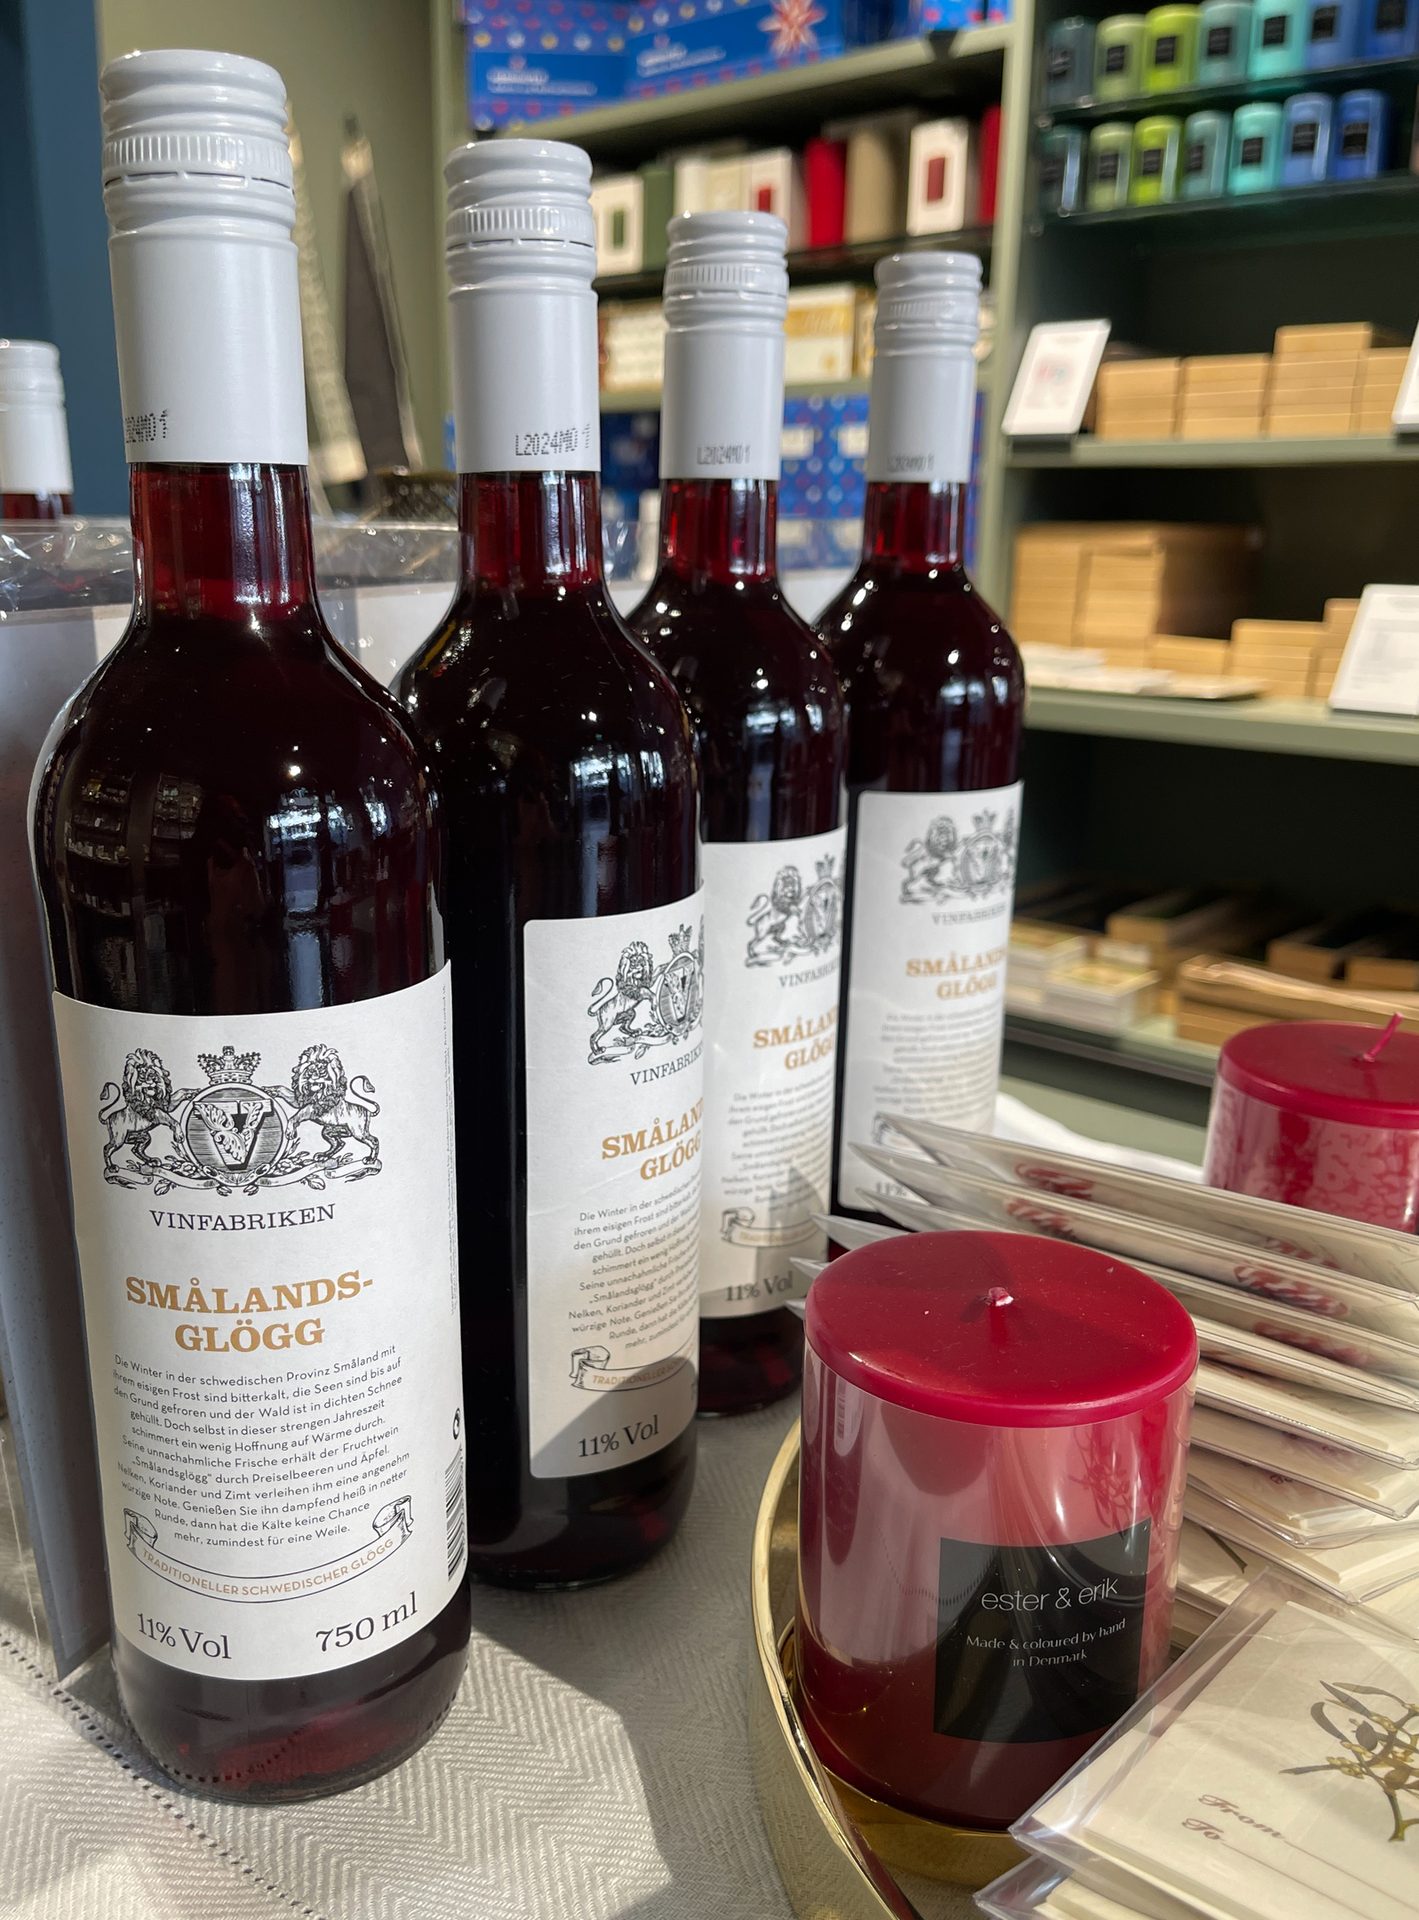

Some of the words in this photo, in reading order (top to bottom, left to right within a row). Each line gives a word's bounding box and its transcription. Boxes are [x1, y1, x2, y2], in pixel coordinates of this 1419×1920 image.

[601, 1097, 704, 1160] SMÅLAN
[148, 1203, 336, 1231] VINFABRIKEN
[573, 1226, 601, 1236] ihrem
[602, 1221, 633, 1232] eisigen
[580, 1212, 595, 1222] Die
[597, 1207, 629, 1219] Winter
[639, 1200, 653, 1210] der
[573, 1241, 591, 1251] den
[593, 1234, 623, 1248] Grund
[125, 1270, 374, 1315] SMÅLANDS-
[579, 1281, 605, 1292] Seine
[725, 1282, 760, 1301] 11%
[763, 1270, 793, 1295] Vol
[174, 1317, 326, 1353] GLÖGG
[571, 1321, 608, 1333] würzige
[114, 1353, 129, 1367] Die
[130, 1360, 163, 1378] Winter
[165, 1370, 175, 1381] in
[177, 1372, 197, 1384] der
[200, 1374, 283, 1386] schwedischen
[286, 1369, 331, 1382] Provinz
[333, 1351, 379, 1373] Småland
[381, 1344, 396, 1358] mit
[137, 1380, 170, 1396] eisigen
[172, 1387, 201, 1402] Frost
[204, 1392, 228, 1402] sind
[230, 1391, 289, 1403] bitterkalt,
[292, 1387, 311, 1398] die
[314, 1381, 343, 1394] Seen
[346, 1371, 368, 1387] sind
[370, 1366, 385, 1379] bis
[386, 1356, 402, 1372] auf
[113, 1386, 129, 1400] den
[129, 1392, 159, 1410] Grund
[161, 1403, 207, 1418] gefroren
[209, 1409, 231, 1419] und
[234, 1408, 255, 1419] der
[258, 1405, 290, 1418] Wald
[293, 1403, 308, 1414] ist
[310, 1401, 321, 1411] in
[323, 1392, 366, 1408] dichten
[367, 1375, 403, 1396] Schnee
[130, 1409, 163, 1427] gehüllt.
[164, 1418, 191, 1432] Doch
[193, 1424, 226, 1436] selbst
[228, 1426, 239, 1435] in
[241, 1424, 278, 1435] dieser
[280, 1416, 331, 1432] strengen
[332, 1398, 386, 1424] Jahreszeit
[131, 1426, 180, 1447] schimmert
[182, 1439, 198, 1449] ein
[199, 1442, 232, 1454] wenig
[234, 1440, 289, 1452] Hoffnung
[291, 1434, 310, 1447] auf
[311, 1429, 353, 1444] Wärme
[354, 1415, 386, 1434] durch.
[578, 1432, 620, 1458] 11%
[623, 1414, 660, 1446] Vol
[122, 1434, 145, 1453] Seine
[147, 1447, 232, 1468] unnachahmliche
[234, 1457, 278, 1468] Frische
[281, 1451, 316, 1464] erhält
[319, 1447, 339, 1459] der
[342, 1426, 400, 1452] Fruchtwein
[215, 1474, 249, 1484] durch
[252, 1465, 335, 1483] Preiselbeeren
[336, 1456, 358, 1471] und
[360, 1445, 390, 1463] Äpfel.
[121, 1480, 151, 1501] würzige
[153, 1493, 180, 1509] Note.
[182, 1501, 237, 1516] Genießen
[239, 1505, 258, 1516] Sie
[260, 1505, 279, 1515] ihn
[281, 1494, 340, 1512] dampfend
[342, 1485, 367, 1502] heiß
[368, 1482, 378, 1493] in
[379, 1468, 408, 1489] netter
[148, 1476, 198, 1496] Koriander
[200, 1489, 222, 1499] und
[224, 1489, 251, 1500] Zimt
[254, 1485, 310, 1499] verleihen
[312, 1482, 333, 1492] ihm
[335, 1475, 359, 1487] eine
[361, 1452, 411, 1479] angenehm
[154, 1508, 189, 1527] Runde,
[190, 1519, 217, 1531] dann
[219, 1521, 238, 1532] hat
[240, 1521, 258, 1531] die
[262, 1518, 292, 1530] Kälte
[294, 1514, 326, 1526] keine
[328, 1501, 370, 1520] Chance
[174, 1531, 203, 1545] mehr,
[206, 1537, 264, 1548] zumindest
[267, 1534, 285, 1545] für
[287, 1533, 313, 1544] eine
[315, 1524, 351, 1539] Weile.
[142, 1548, 239, 1596] TRADITIONELLER
[241, 1565, 349, 1596] SCHWEDISCHER
[350, 1538, 394, 1571] GLÖGG
[981, 1589, 1050, 1612] ester
[1055, 1587, 1072, 1610] &
[1078, 1577, 1119, 1606] erik
[137, 1612, 176, 1648] 11%
[178, 1626, 232, 1660] Vol
[315, 1617, 375, 1652] 750
[381, 1591, 418, 1632] ml
[966, 1635, 1007, 1650] Made
[1009, 1639, 1020, 1650] &
[1022, 1635, 1080, 1651] coloured
[1082, 1630, 1097, 1644] by
[1098, 1618, 1127, 1638] hand
[1012, 1657, 1025, 1668] in
[1029, 1649, 1088, 1668] Denmark
[1181, 1817, 1224, 1842] To
[1198, 1793, 1286, 1841] From
